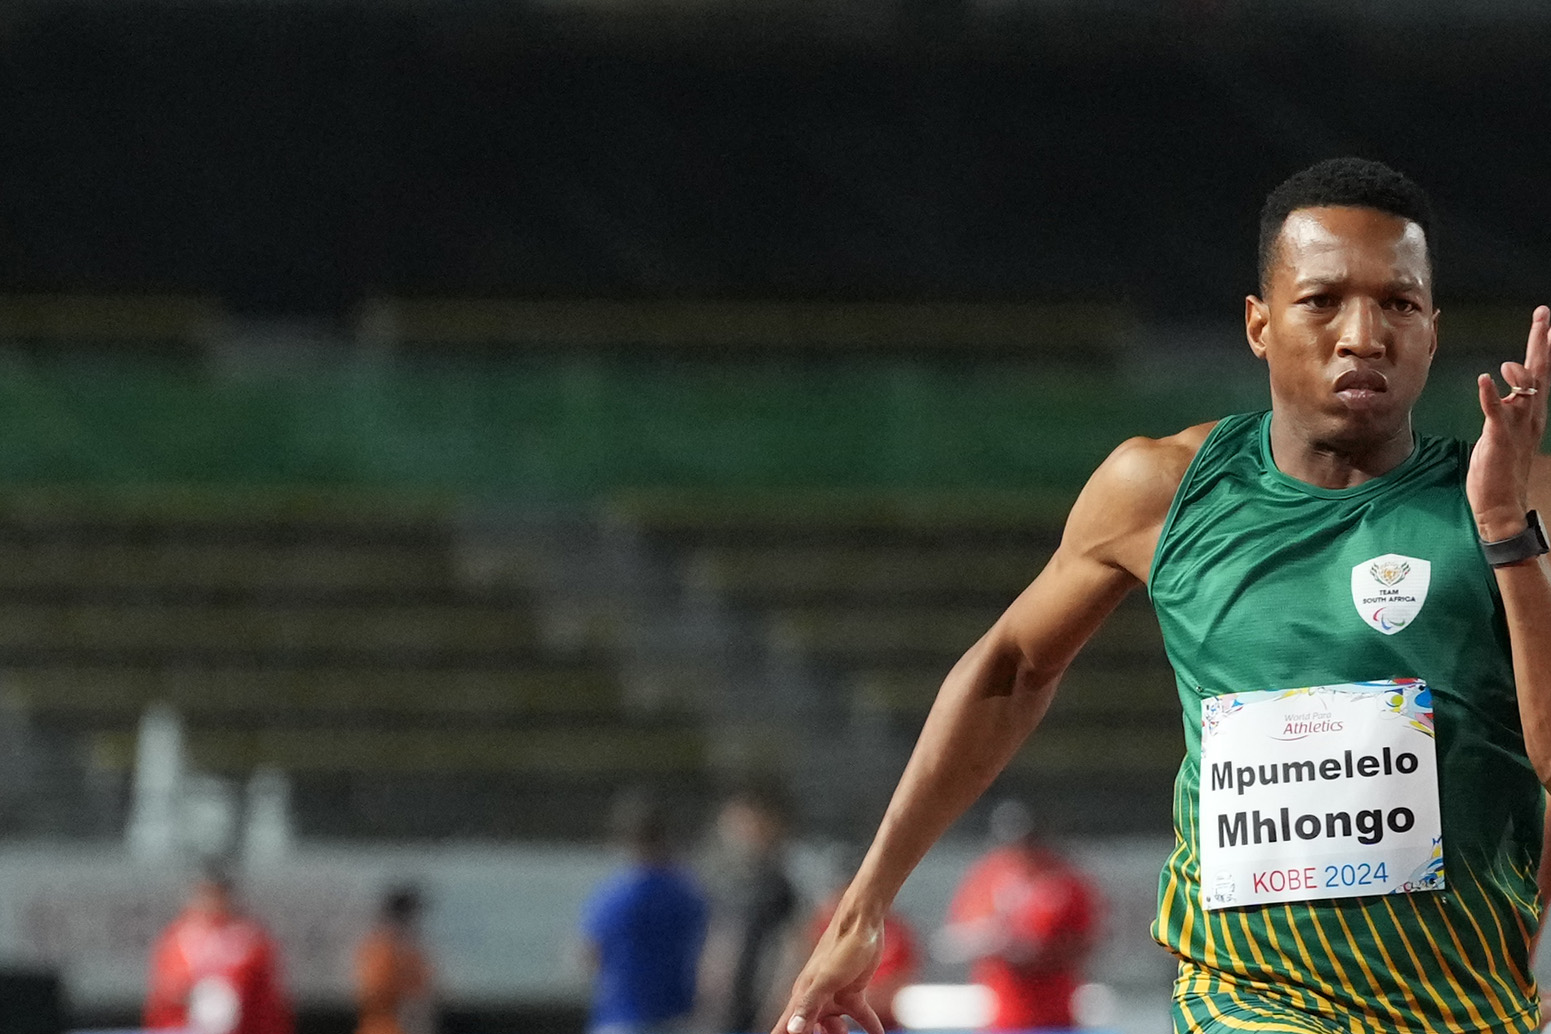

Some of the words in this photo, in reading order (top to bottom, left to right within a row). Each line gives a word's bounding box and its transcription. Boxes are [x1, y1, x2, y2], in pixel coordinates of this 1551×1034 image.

[1283, 720, 1343, 735] Athletics
[1284, 713, 1311, 721] World
[1312, 712, 1332, 720] Para
[1211, 746, 1419, 796] Mpumelelo
[1217, 805, 1415, 848] Mhlongo
[1253, 867, 1317, 894] KOBE
[1325, 862, 1389, 888] 2024
